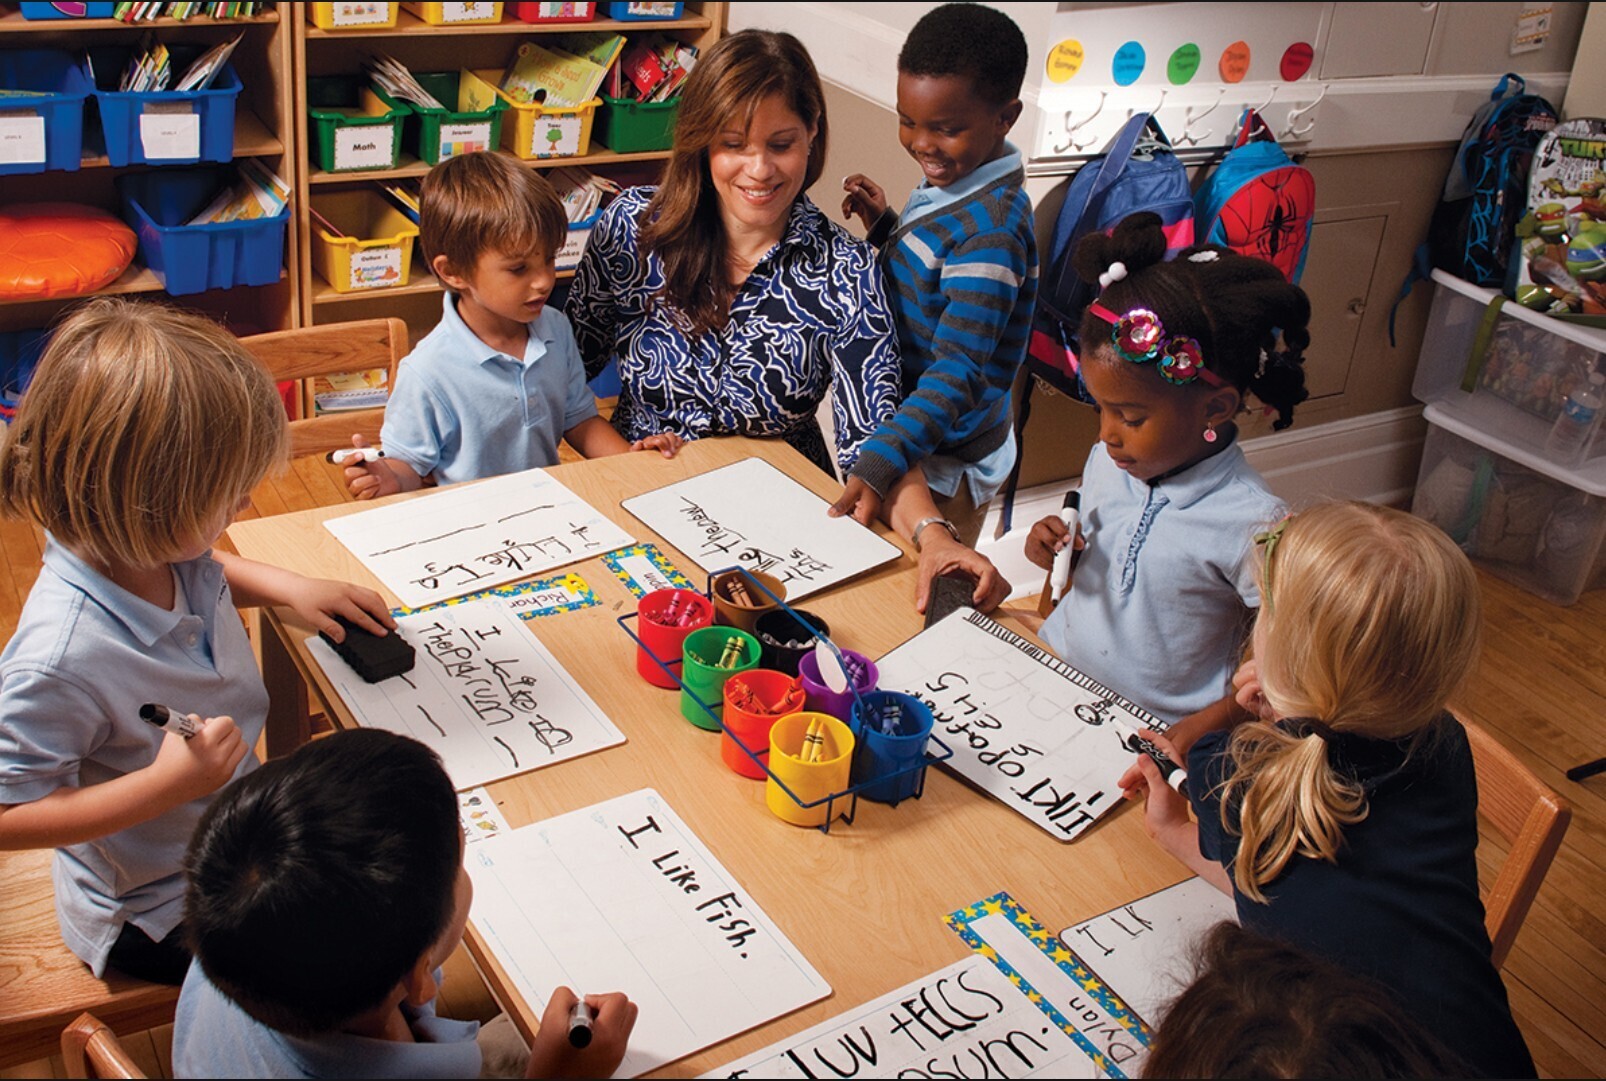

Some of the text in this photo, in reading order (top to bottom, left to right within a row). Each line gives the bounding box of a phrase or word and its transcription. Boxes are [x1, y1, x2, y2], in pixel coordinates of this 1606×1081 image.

[352, 142, 376, 152] Math
[617, 815, 757, 959] I Like Fish.
[1075, 925, 1115, 957] I
[1069, 996, 1138, 1065] Dylan
